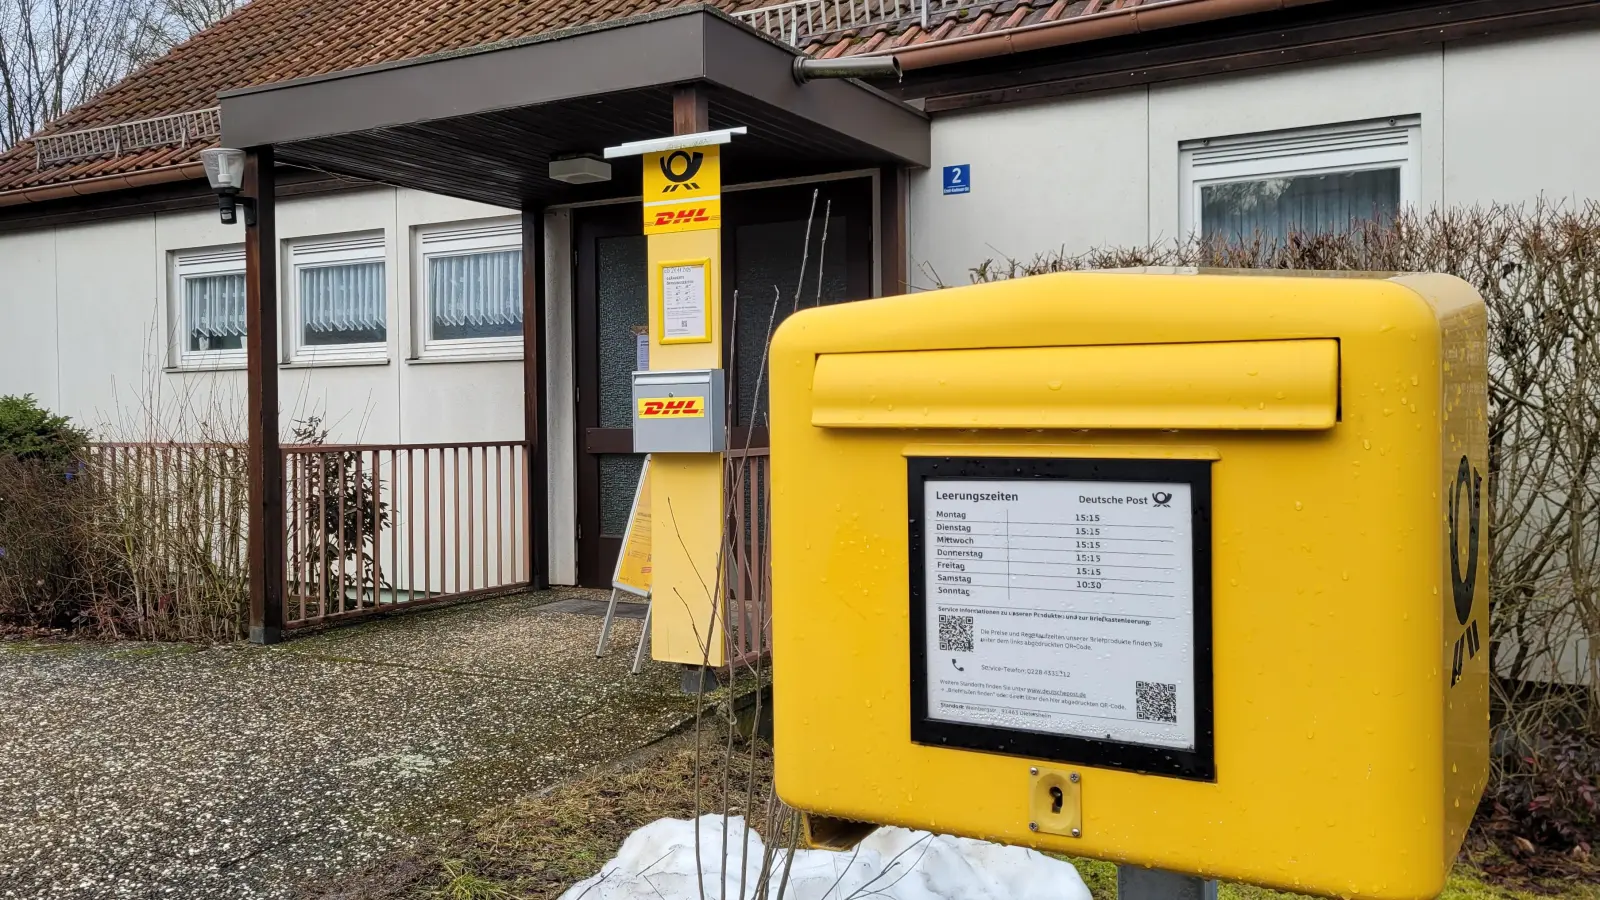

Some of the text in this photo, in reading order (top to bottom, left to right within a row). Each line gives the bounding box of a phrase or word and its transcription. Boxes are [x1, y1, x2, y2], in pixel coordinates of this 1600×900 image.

[952, 168, 962, 184] 2
[654, 208, 710, 226] DHL
[644, 400, 699, 415] DHL
[936, 491, 1018, 502] Leerungszeiten
[1078, 495, 1148, 504] Deutsche Post
[936, 510, 966, 520] Montag
[1076, 514, 1100, 522] 15:15
[936, 524, 971, 532] Dienstag
[1076, 528, 1100, 536] 15:15
[936, 536, 974, 544] Mittwoch
[937, 548, 983, 558] Donnerstag
[938, 562, 966, 571] Freitag
[1076, 568, 1101, 576] 15:15
[938, 574, 972, 584] Samstag
[1076, 581, 1102, 589] 10:30
[938, 586, 970, 596] Sonntag
